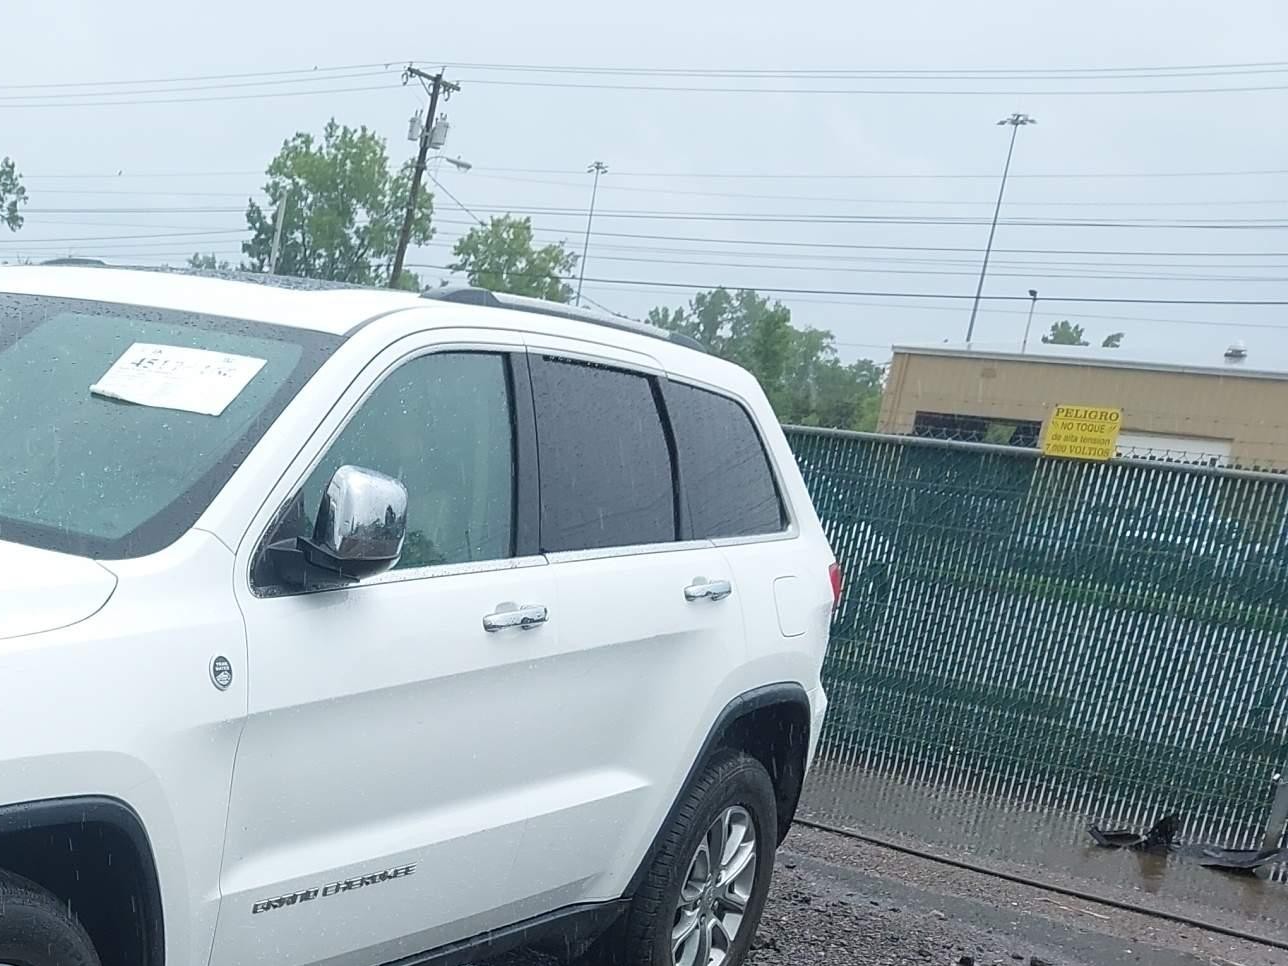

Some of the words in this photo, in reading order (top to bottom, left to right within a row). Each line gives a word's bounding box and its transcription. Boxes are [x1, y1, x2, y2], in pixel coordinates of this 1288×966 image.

[1055, 407, 1120, 422] PELIGRO
[1060, 421, 1074, 431] NO
[1076, 422, 1105, 434] TOQUE
[1069, 444, 1110, 457] VOLTIOS
[252, 887, 319, 914] GRAND
[321, 862, 418, 897] CHEROKEE
